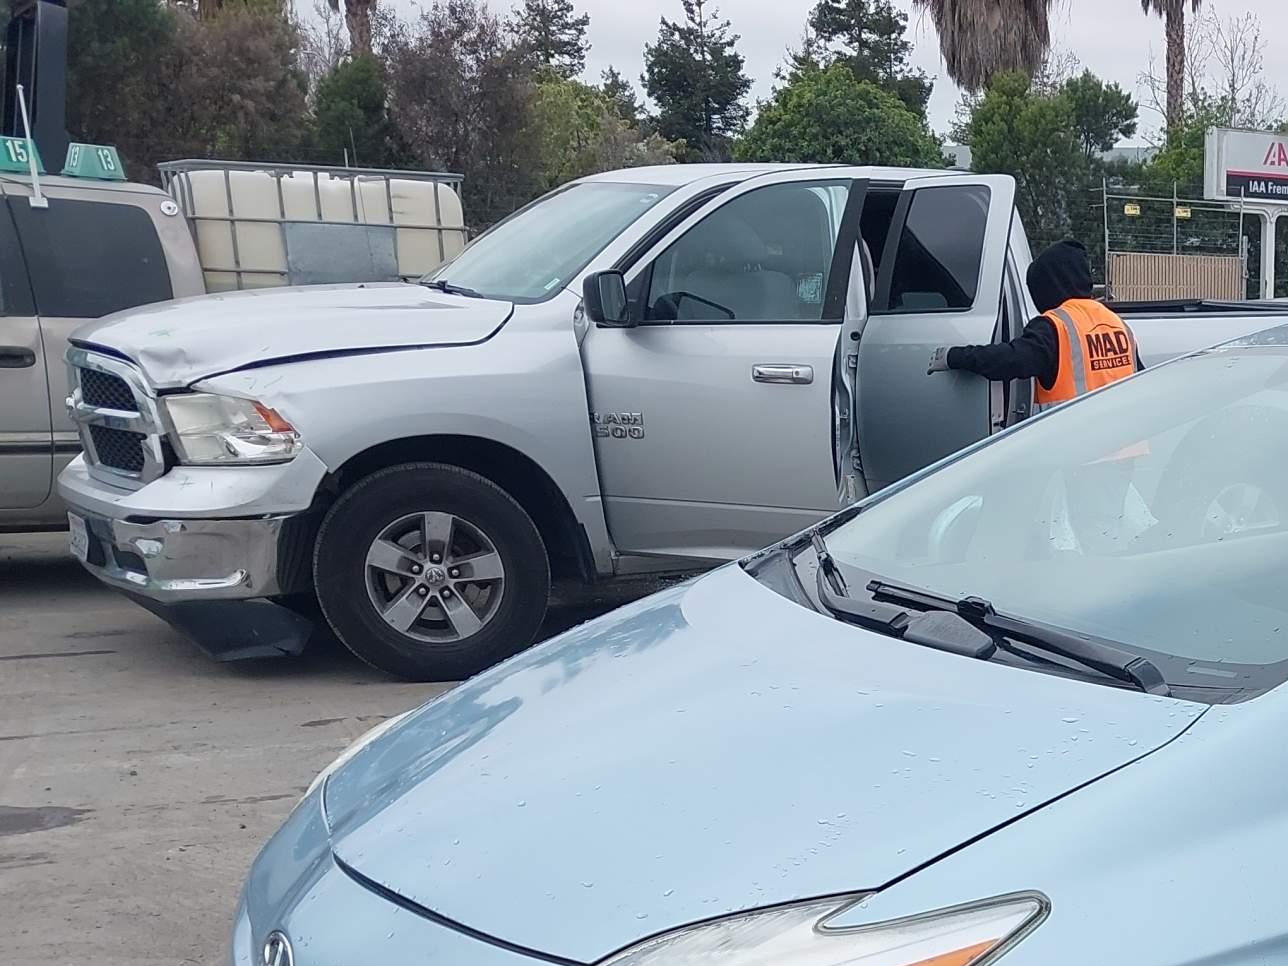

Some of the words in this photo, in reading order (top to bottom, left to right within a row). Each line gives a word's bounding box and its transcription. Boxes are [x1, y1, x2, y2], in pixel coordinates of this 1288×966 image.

[6, 139, 28, 162] 15
[97, 148, 115, 171] 13
[1249, 180, 1266, 197] IAA
[1085, 330, 1129, 359] MAD
